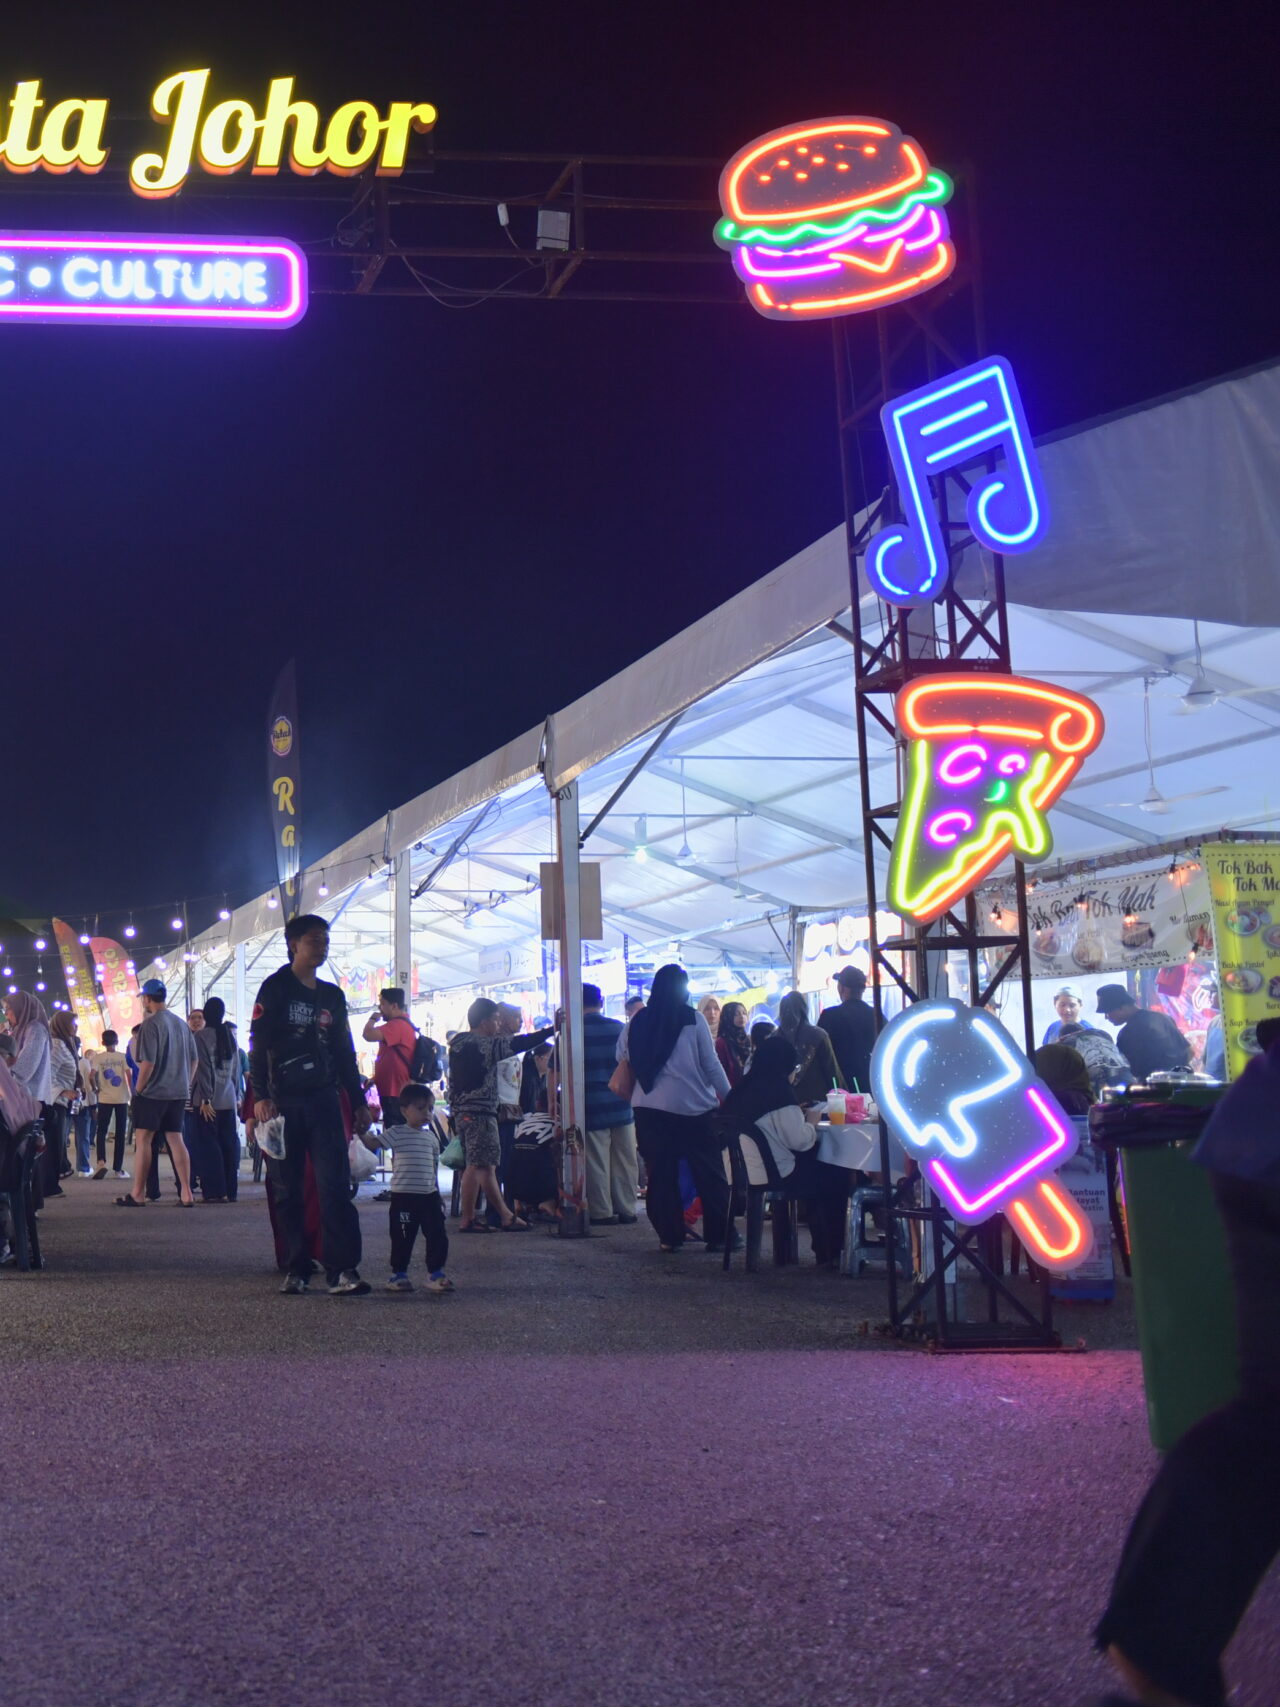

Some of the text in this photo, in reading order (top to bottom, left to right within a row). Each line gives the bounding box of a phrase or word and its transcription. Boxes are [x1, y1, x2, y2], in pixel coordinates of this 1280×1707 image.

[129, 67, 437, 198] Johor
[61, 256, 268, 303] CULTURE
[1217, 859, 1273, 875] Tok Bak
[1233, 876, 1257, 892] Tok
